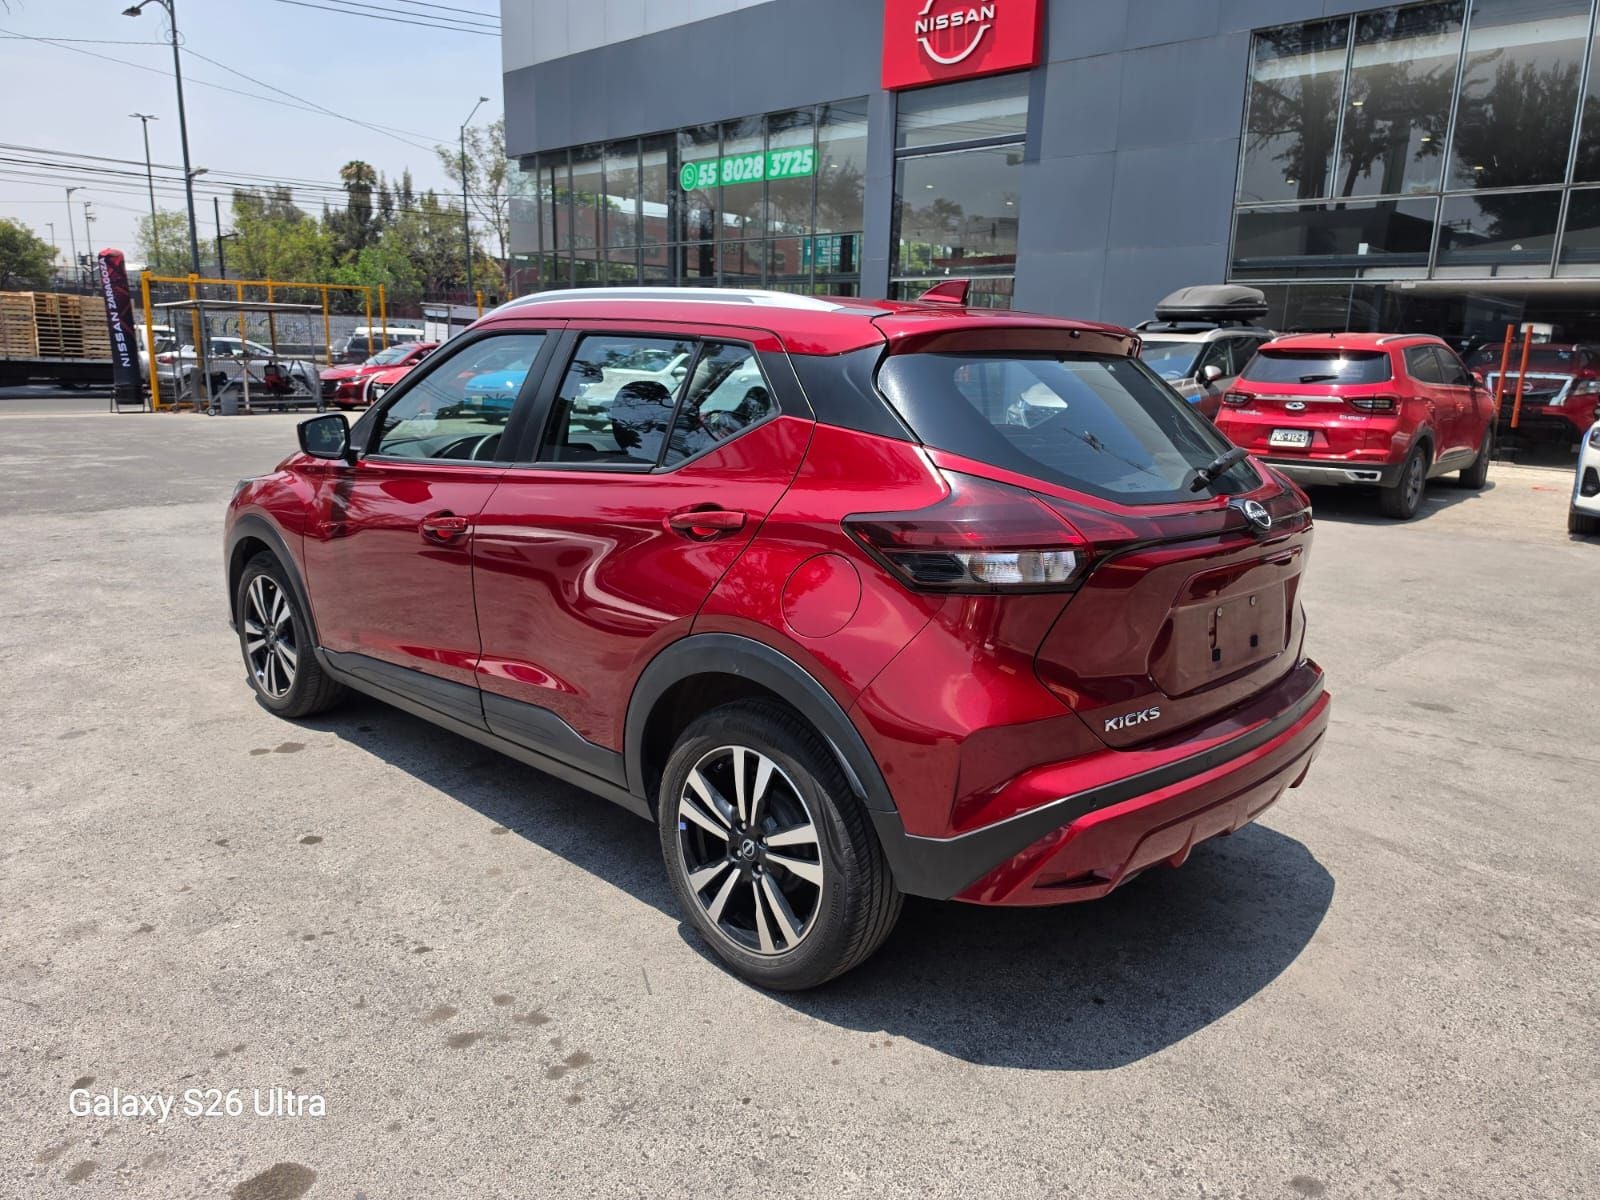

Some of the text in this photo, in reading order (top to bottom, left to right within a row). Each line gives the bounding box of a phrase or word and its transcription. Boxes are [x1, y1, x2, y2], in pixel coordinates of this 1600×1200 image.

[914, 4, 995, 34] NISSAN
[698, 149, 814, 186] 55 8028 3725
[100, 257, 131, 367] NISSAN ZARAGOZA
[1104, 706, 1160, 732] KICKS
